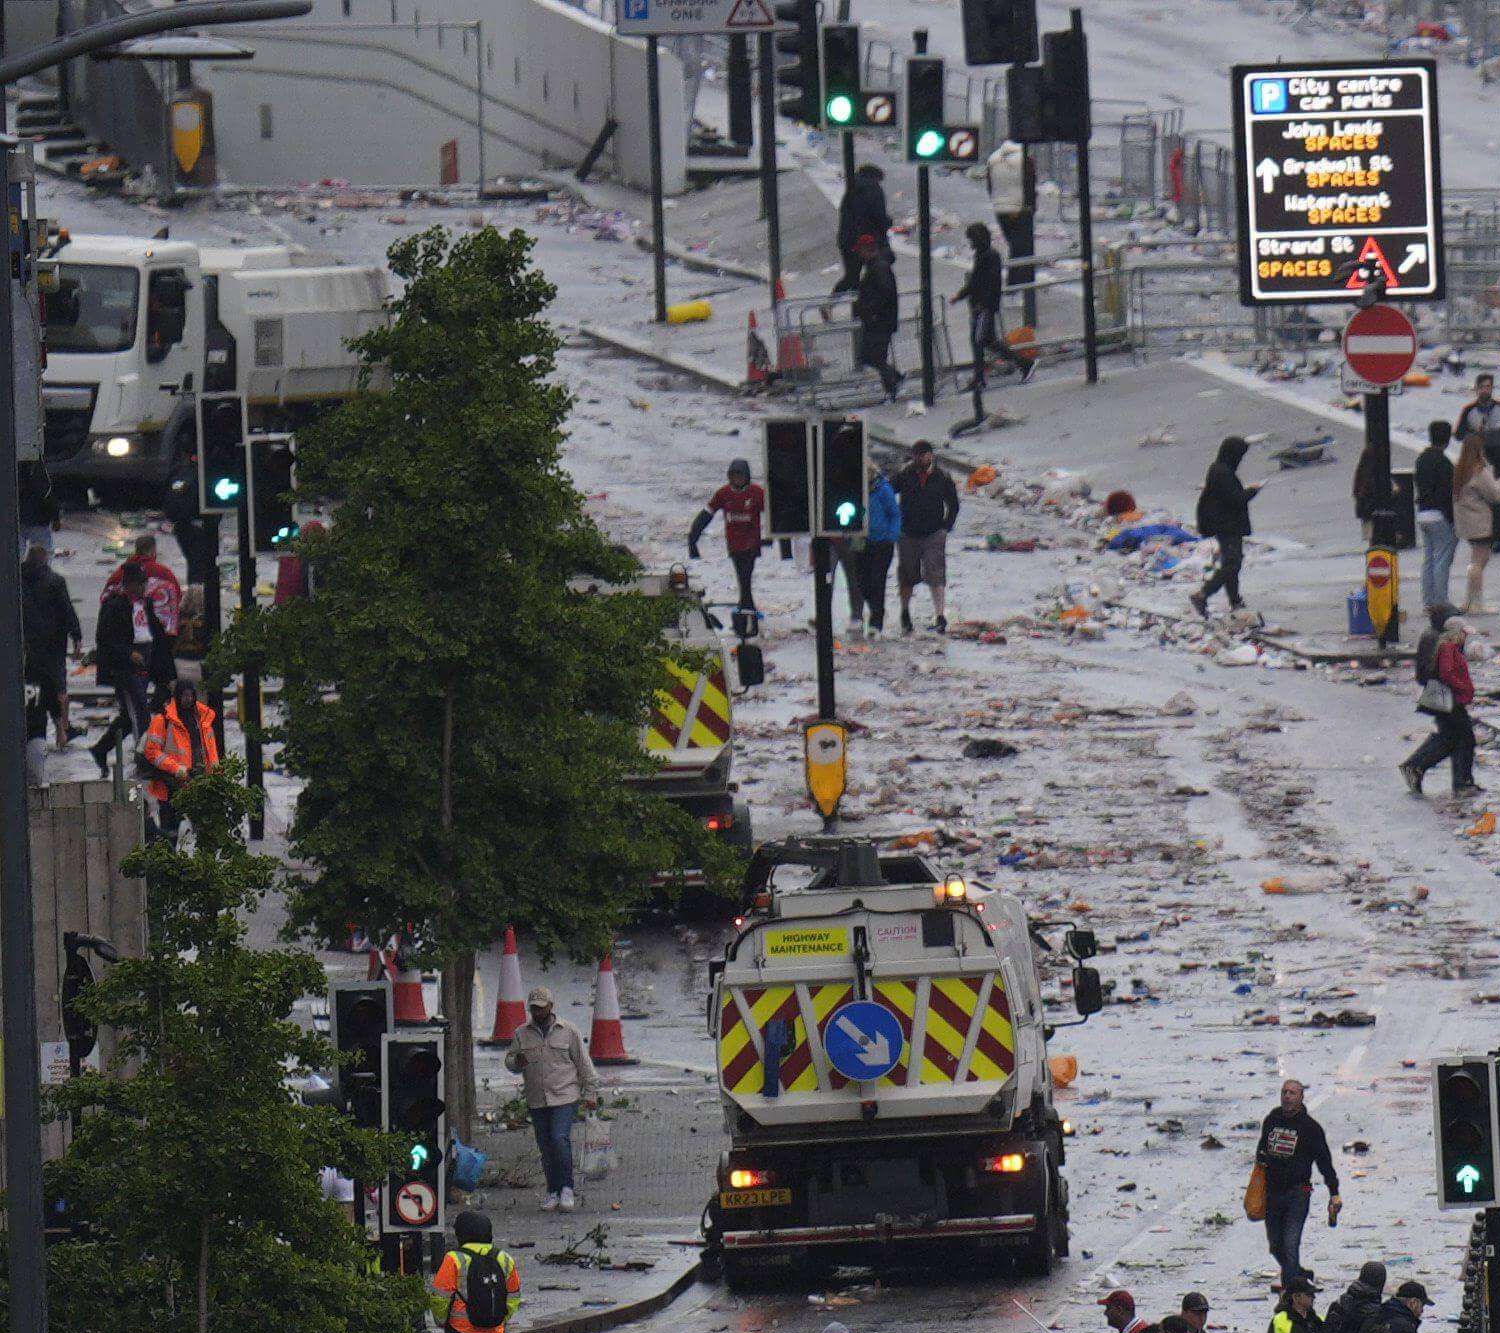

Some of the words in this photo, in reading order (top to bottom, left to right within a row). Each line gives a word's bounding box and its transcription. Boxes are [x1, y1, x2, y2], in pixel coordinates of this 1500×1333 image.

[1289, 77, 1329, 97] City
[1338, 76, 1402, 94] centre
[1300, 96, 1332, 111] car
[1340, 92, 1392, 110] parks
[1283, 122, 1326, 140] John
[1334, 120, 1382, 137] Lewis
[1305, 135, 1379, 152] SPACES
[1284, 157, 1361, 176] Gradwell
[1378, 155, 1393, 173] St
[1307, 171, 1380, 189] SPACES
[1284, 193, 1391, 212] Waterfront
[1308, 208, 1381, 225] SPACES
[1259, 237, 1324, 256] Strand
[1331, 237, 1355, 254] St
[1259, 260, 1332, 279] SPACES
[782, 931, 832, 944] HIGHWAY
[771, 941, 844, 955] MAINTENANCE
